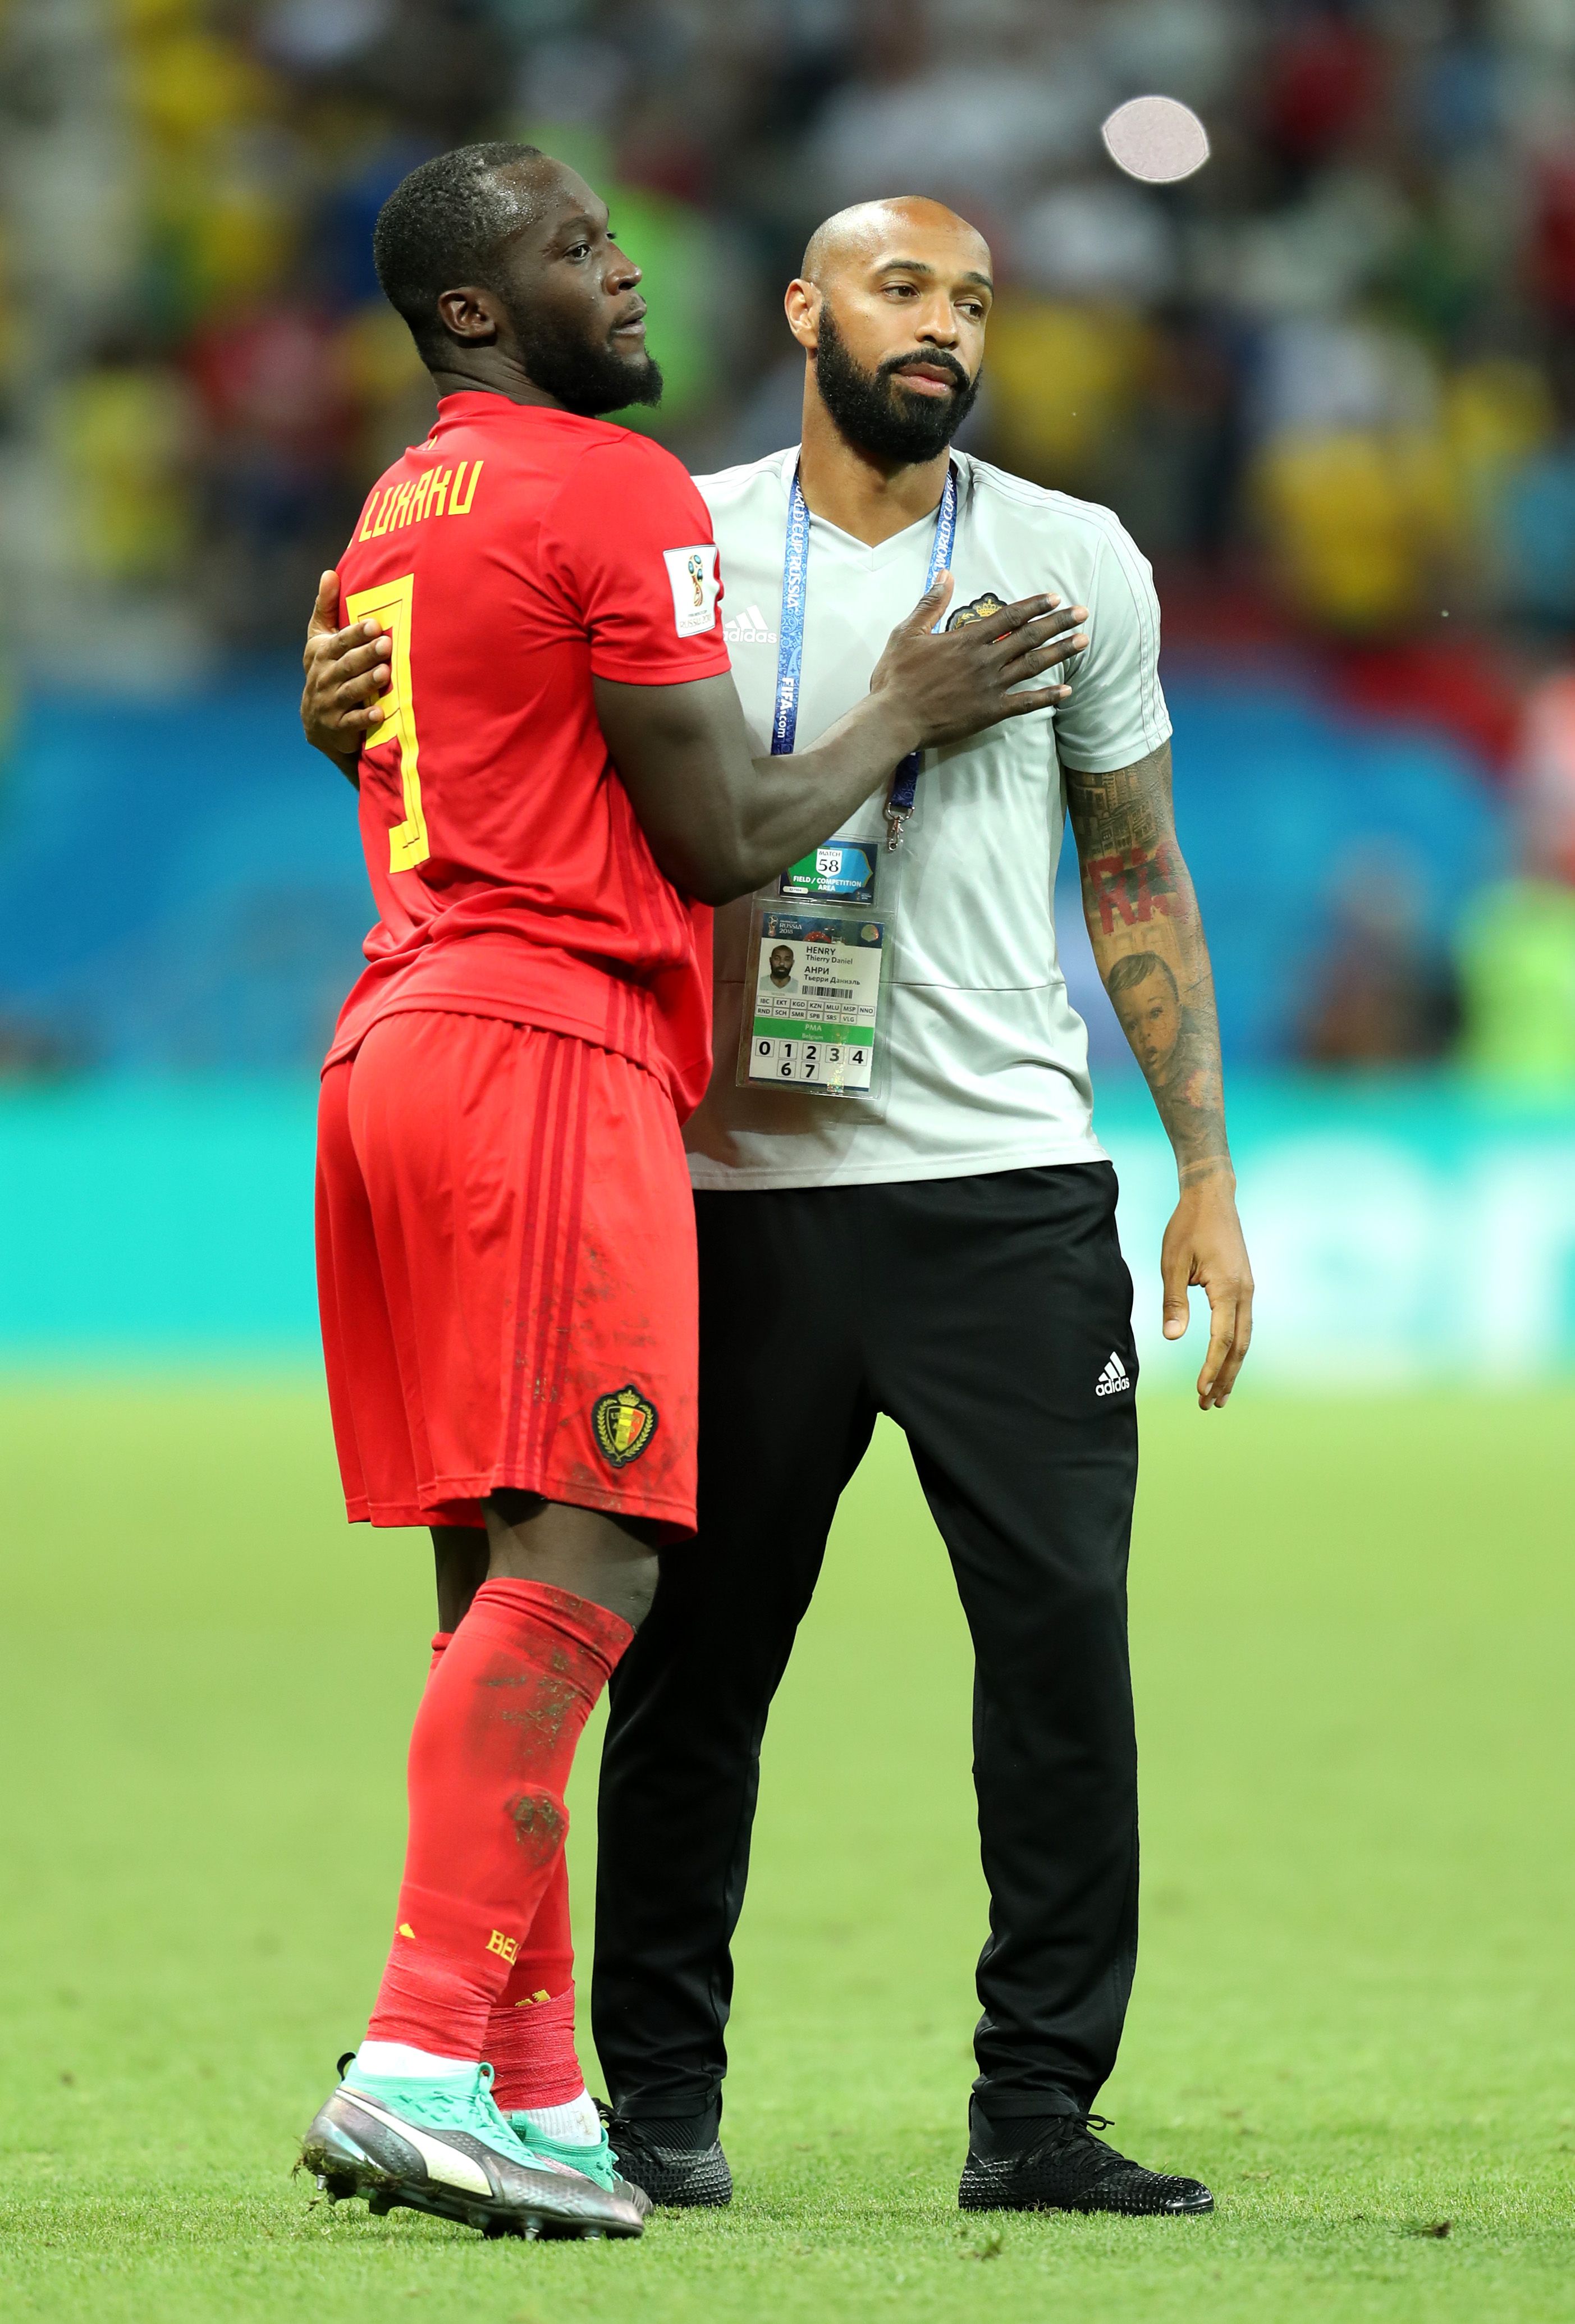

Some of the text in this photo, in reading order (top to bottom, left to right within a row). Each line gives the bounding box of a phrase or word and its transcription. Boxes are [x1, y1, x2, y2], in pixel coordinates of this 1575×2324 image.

[359, 460, 484, 543] LUKAKU
[934, 521, 950, 569] WORLD
[943, 492, 955, 520] CUP
[788, 477, 805, 609] ORLD CUP RUSSIA
[346, 573, 430, 873] 9
[818, 859, 839, 872] 58
[817, 877, 862, 887] COMPETITION
[807, 946, 836, 955] HENRY
[807, 955, 853, 965] Thierry Daniel
[804, 966, 830, 975] АНРИ
[804, 974, 860, 986] Тьерри Даниэль
[759, 1041, 863, 1064] 0 1 2 3 4
[781, 1062, 815, 1078] 6 7
[1096, 1376, 1130, 1397] adidas
[485, 1929, 520, 1966] BEL
